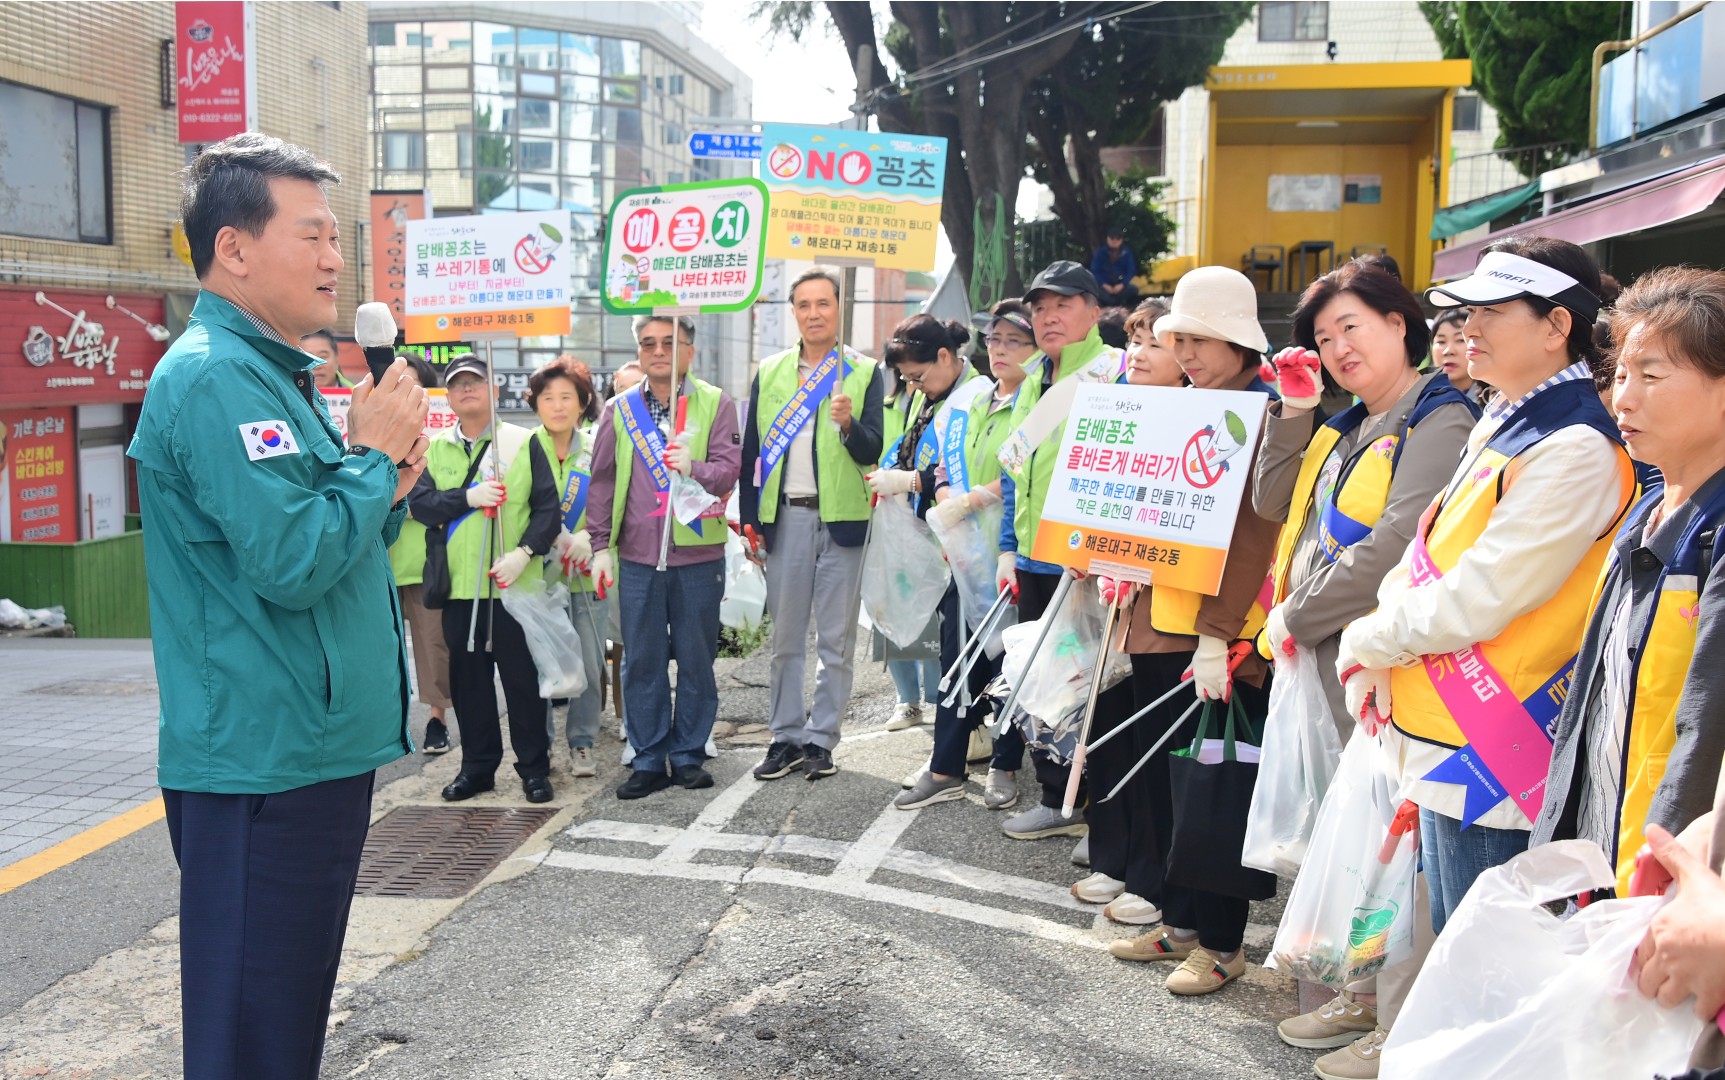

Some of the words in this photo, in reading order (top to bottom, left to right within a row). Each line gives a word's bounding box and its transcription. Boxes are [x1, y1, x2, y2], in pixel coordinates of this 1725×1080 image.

[877, 156, 936, 189] 꽁초
[881, 229, 907, 241] 해운대
[417, 240, 486, 259] 담배꽁초는
[807, 236, 852, 251] 해운대구
[856, 240, 897, 255] 재송1동
[416, 263, 429, 278] 꼭
[435, 258, 506, 277] 쓰레기통에
[653, 256, 687, 271] 해운대
[690, 253, 748, 269] 담배꽁초는
[449, 279, 478, 291] 나부터!
[486, 278, 525, 290] 지금부터!
[674, 271, 707, 287] 나부터
[711, 270, 746, 286] 치우자
[469, 291, 503, 304] 아름다운
[507, 289, 533, 301] 해운대
[537, 288, 563, 300] 만들기
[453, 315, 493, 327] 해운대구
[498, 313, 535, 324] 재송1동
[784, 405, 811, 437] 깨끗한
[1075, 417, 1137, 445] 담배꽁초
[766, 433, 790, 465] 재송동
[1067, 445, 1130, 476] 올바르게
[1131, 451, 1180, 481] 버리기
[1069, 477, 1100, 496] 깨끗한
[1103, 481, 1148, 502] 해운대를
[1151, 487, 1187, 507] 만들기
[1190, 492, 1216, 512] 위한
[1076, 498, 1097, 515] 작은
[1100, 501, 1133, 521] 실천의
[1136, 507, 1196, 532] 시작입니다
[1085, 534, 1132, 557] 해운대구
[1134, 543, 1181, 566] 재송2동
